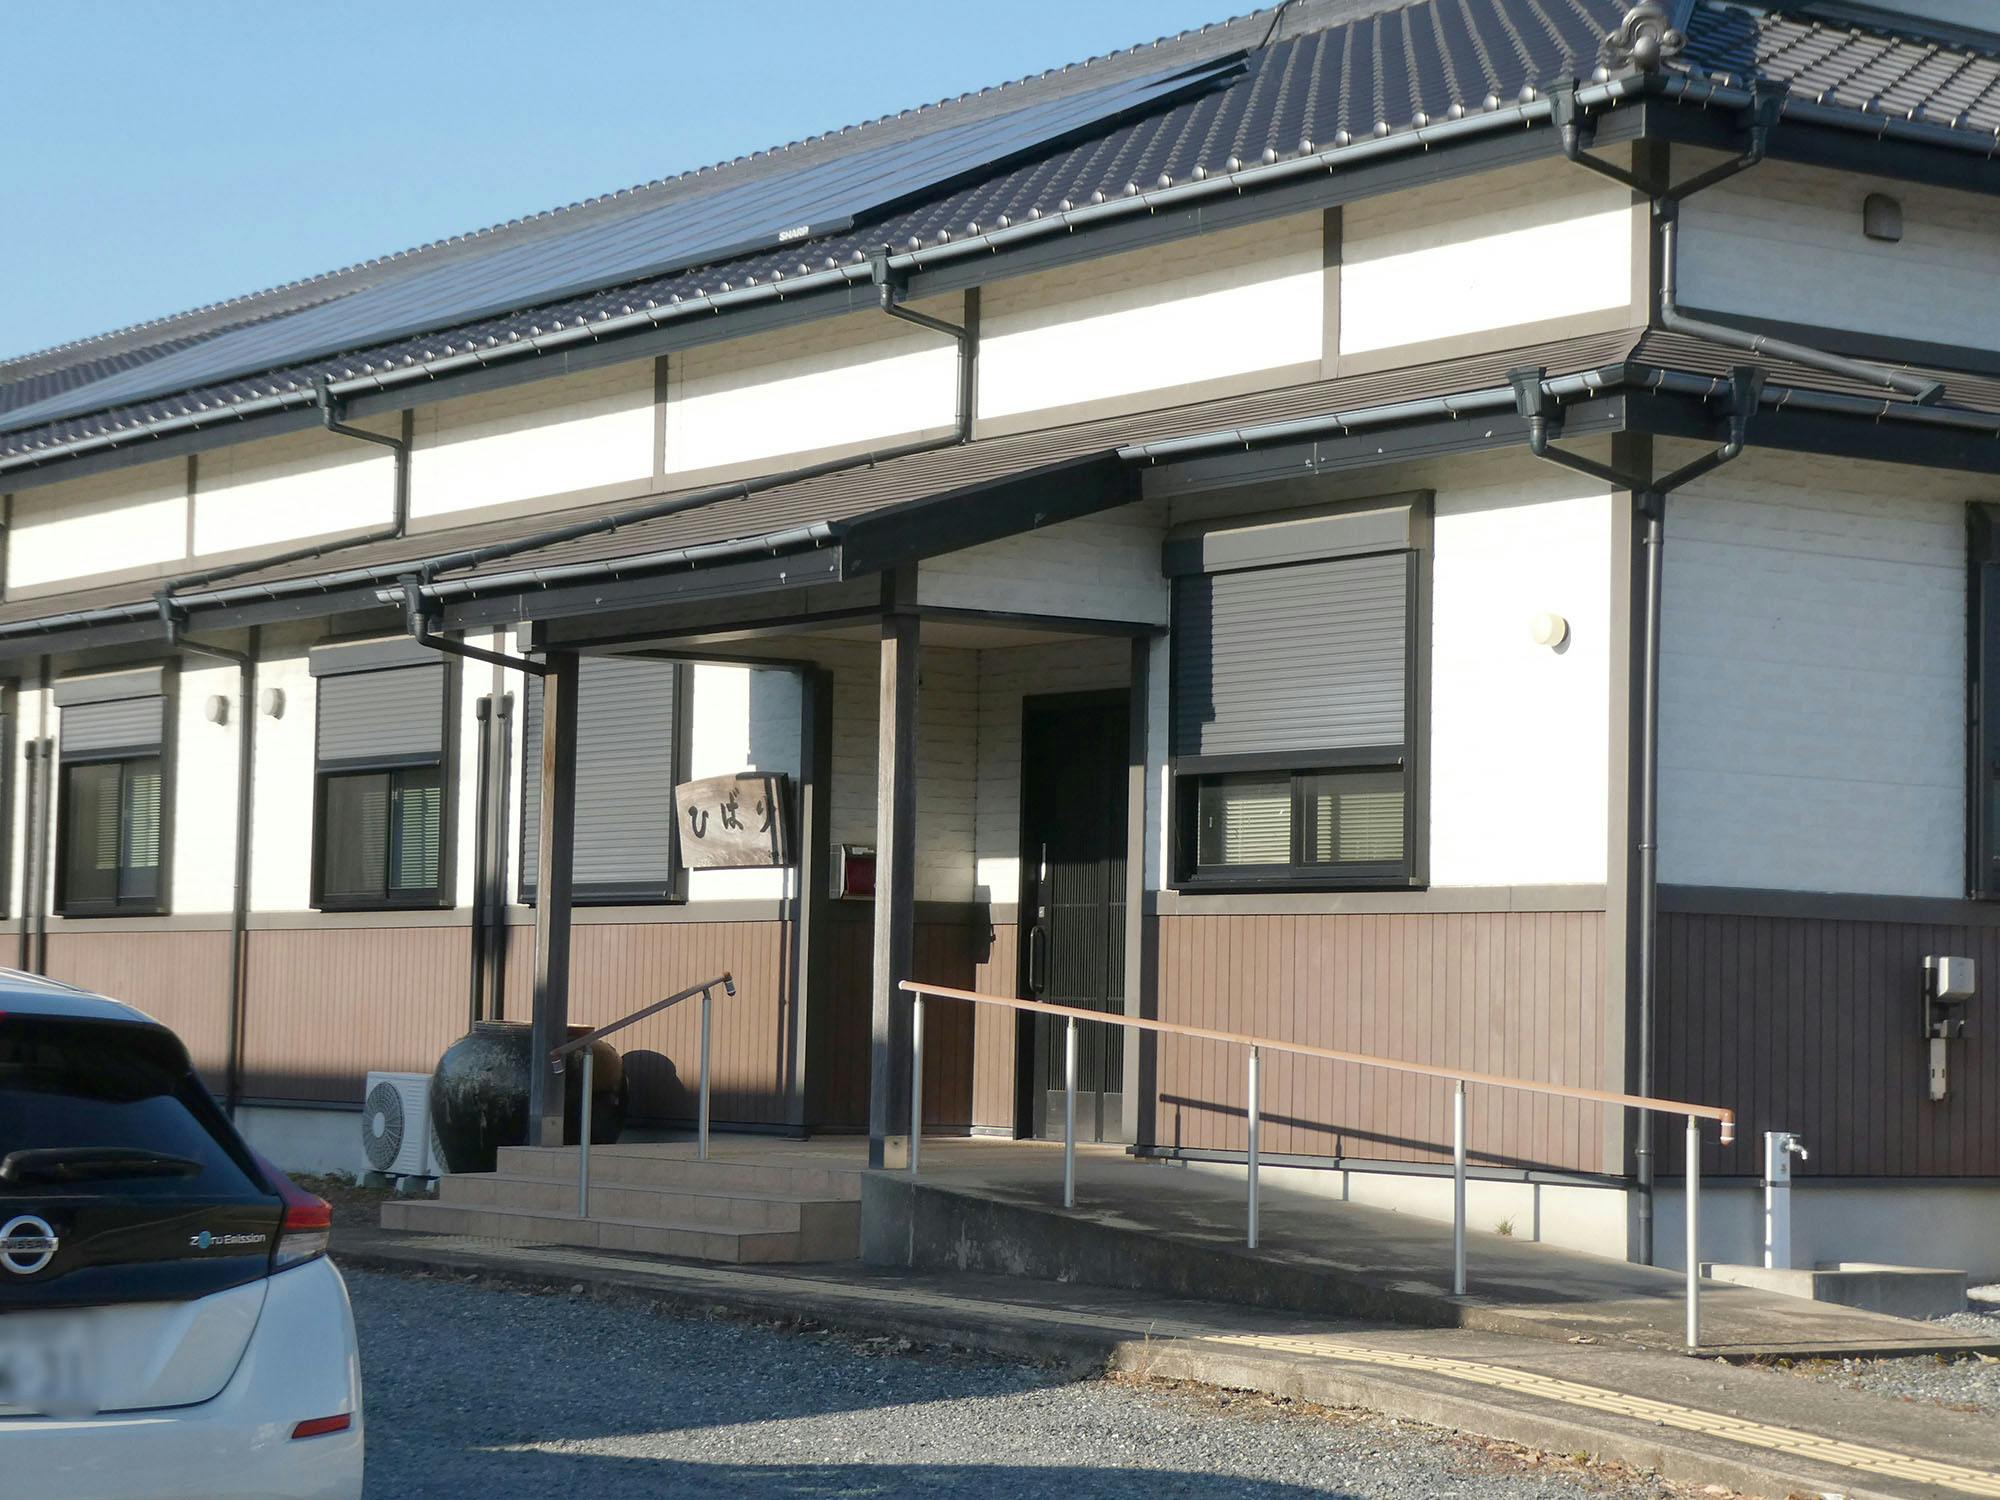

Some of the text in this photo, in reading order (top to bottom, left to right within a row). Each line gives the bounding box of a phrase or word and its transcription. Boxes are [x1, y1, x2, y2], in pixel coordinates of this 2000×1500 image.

[779, 226, 809, 241] SHARP
[688, 787, 771, 838] ひばり
[190, 1230, 222, 1248] Zro
